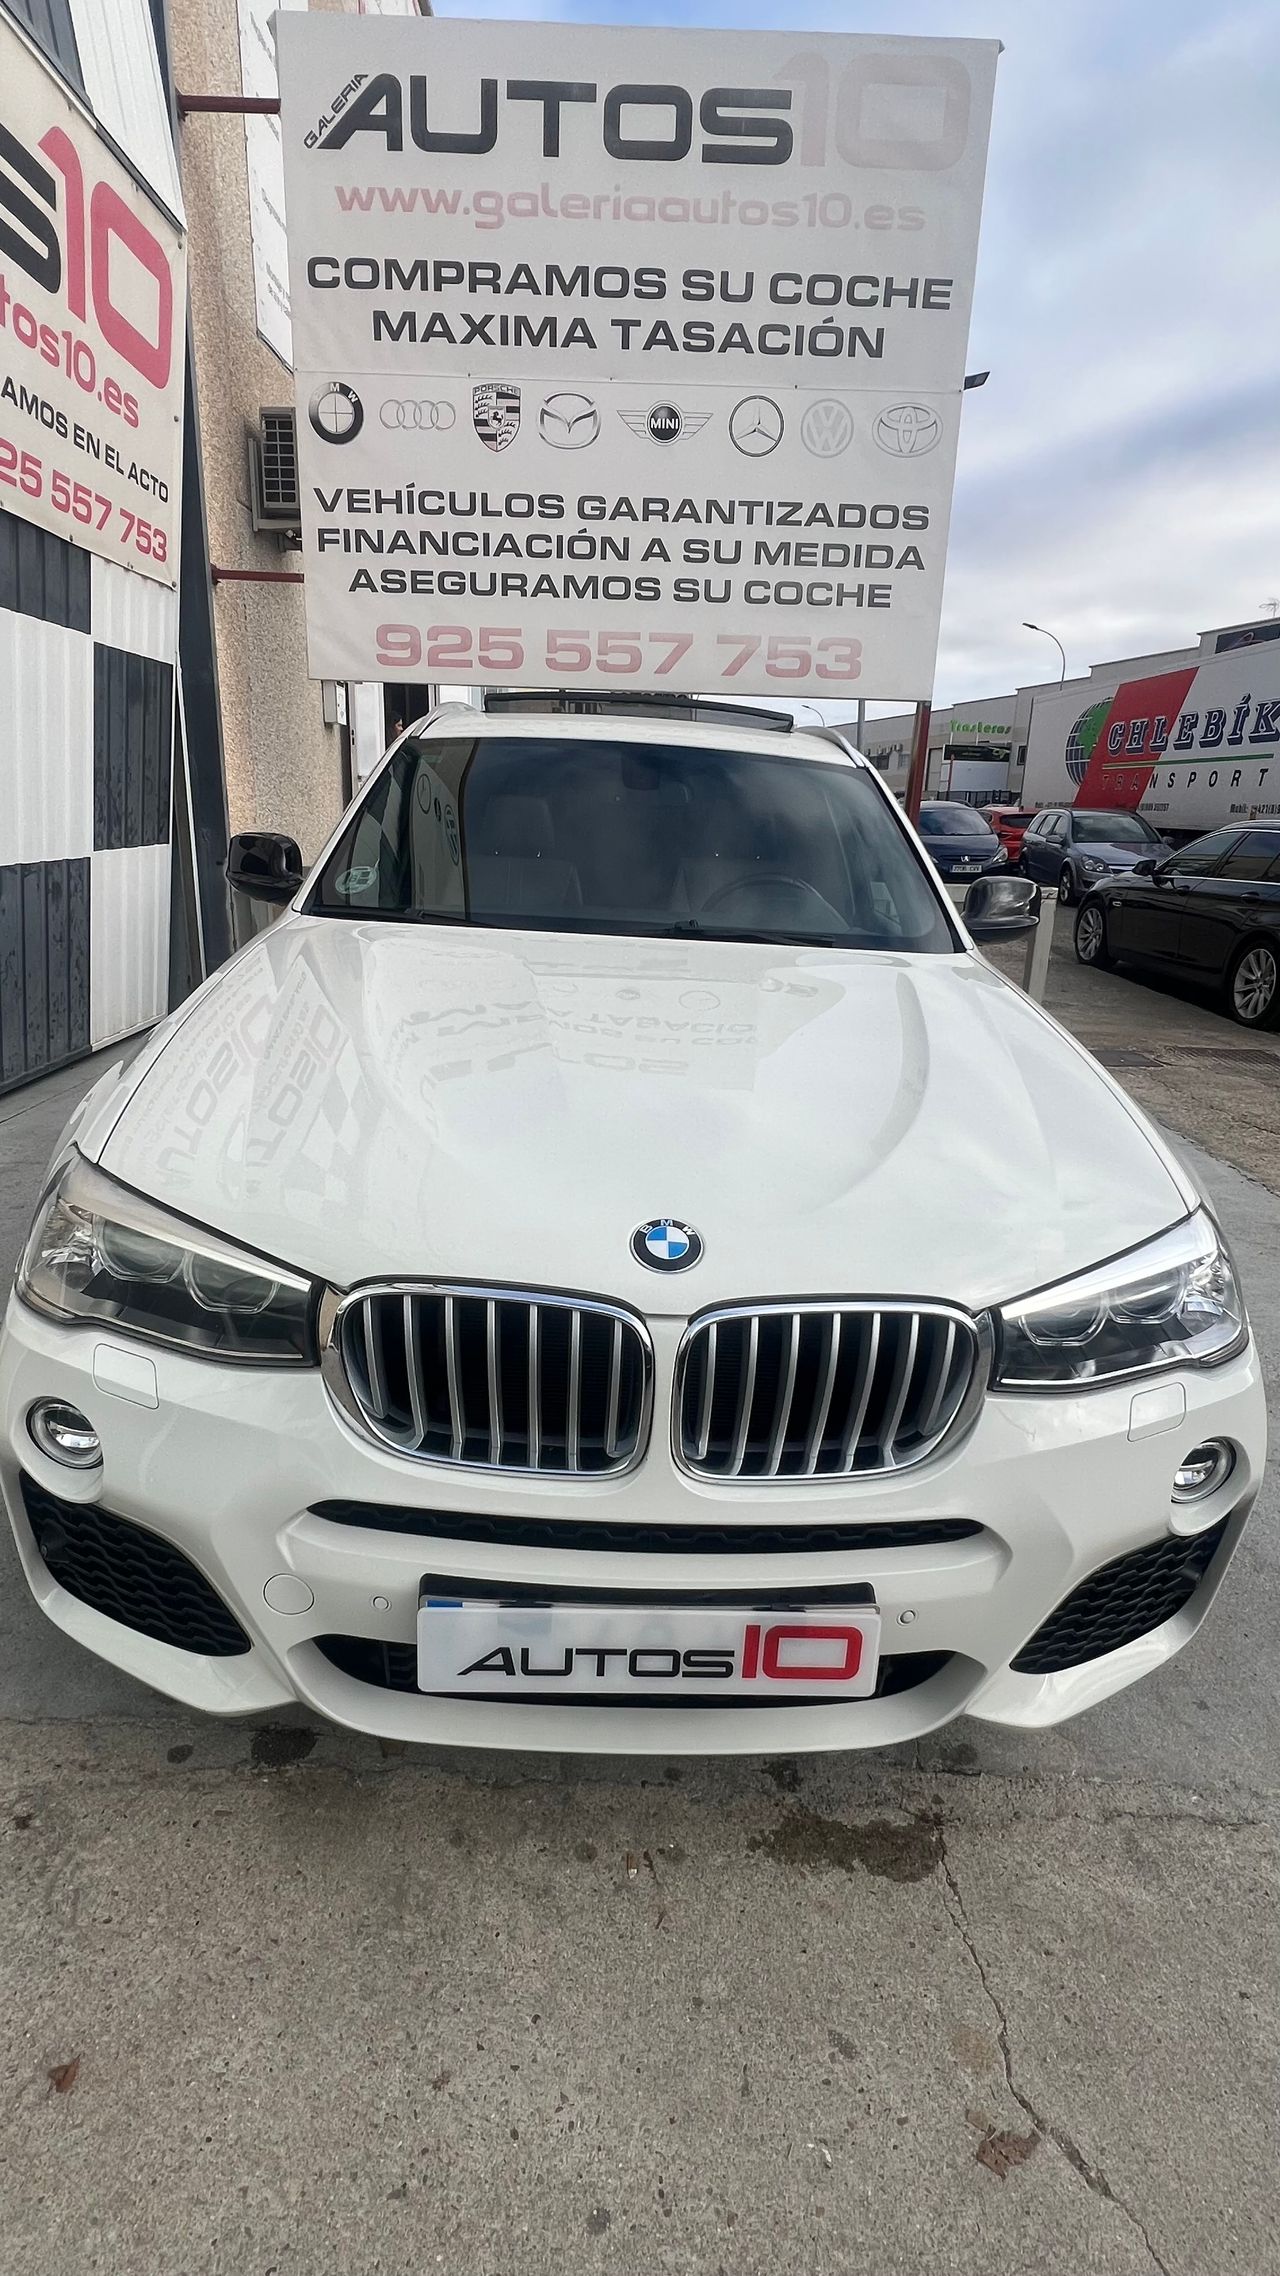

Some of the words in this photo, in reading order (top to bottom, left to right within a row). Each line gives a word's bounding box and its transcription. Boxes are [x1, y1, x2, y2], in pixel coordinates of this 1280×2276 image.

[303, 73, 368, 149] GALERIA
[317, 51, 972, 171] AUTOS10
[334, 182, 927, 230] www.galeriaautos10.es
[307, 256, 667, 299] COMPRAMOS
[682, 269, 754, 303] SU
[769, 272, 954, 310] COCHE
[372, 310, 597, 349] MAXIMA
[611, 316, 885, 358] TASACIÓN
[1, 376, 68, 439] AMOS
[73, 423, 100, 460] EN
[105, 443, 125, 476] EL
[127, 462, 169, 503] ACTO
[650, 417, 679, 430] MINI
[51, 469, 112, 531] 557
[119, 508, 168, 563] 753
[313, 482, 565, 519] VEHÍCULOS
[577, 495, 929, 530] GARANTIZADOS
[317, 527, 630, 561] FINANCIACIÓN
[641, 537, 671, 563] A
[682, 538, 742, 564] SU
[754, 541, 926, 571] MEDIDA
[348, 568, 661, 601] ASEGURAMOS
[673, 578, 732, 603] SU
[744, 580, 893, 608] COCHE
[376, 623, 525, 670] 925
[545, 629, 694, 675] 557
[716, 634, 862, 680] 753
[1107, 692, 1280, 756] CHLEBÍK
[1102, 768, 1269, 791] TRANSPORT
[639, 1219, 696, 1236] BMW
[457, 1624, 863, 1680] AUTOS10
